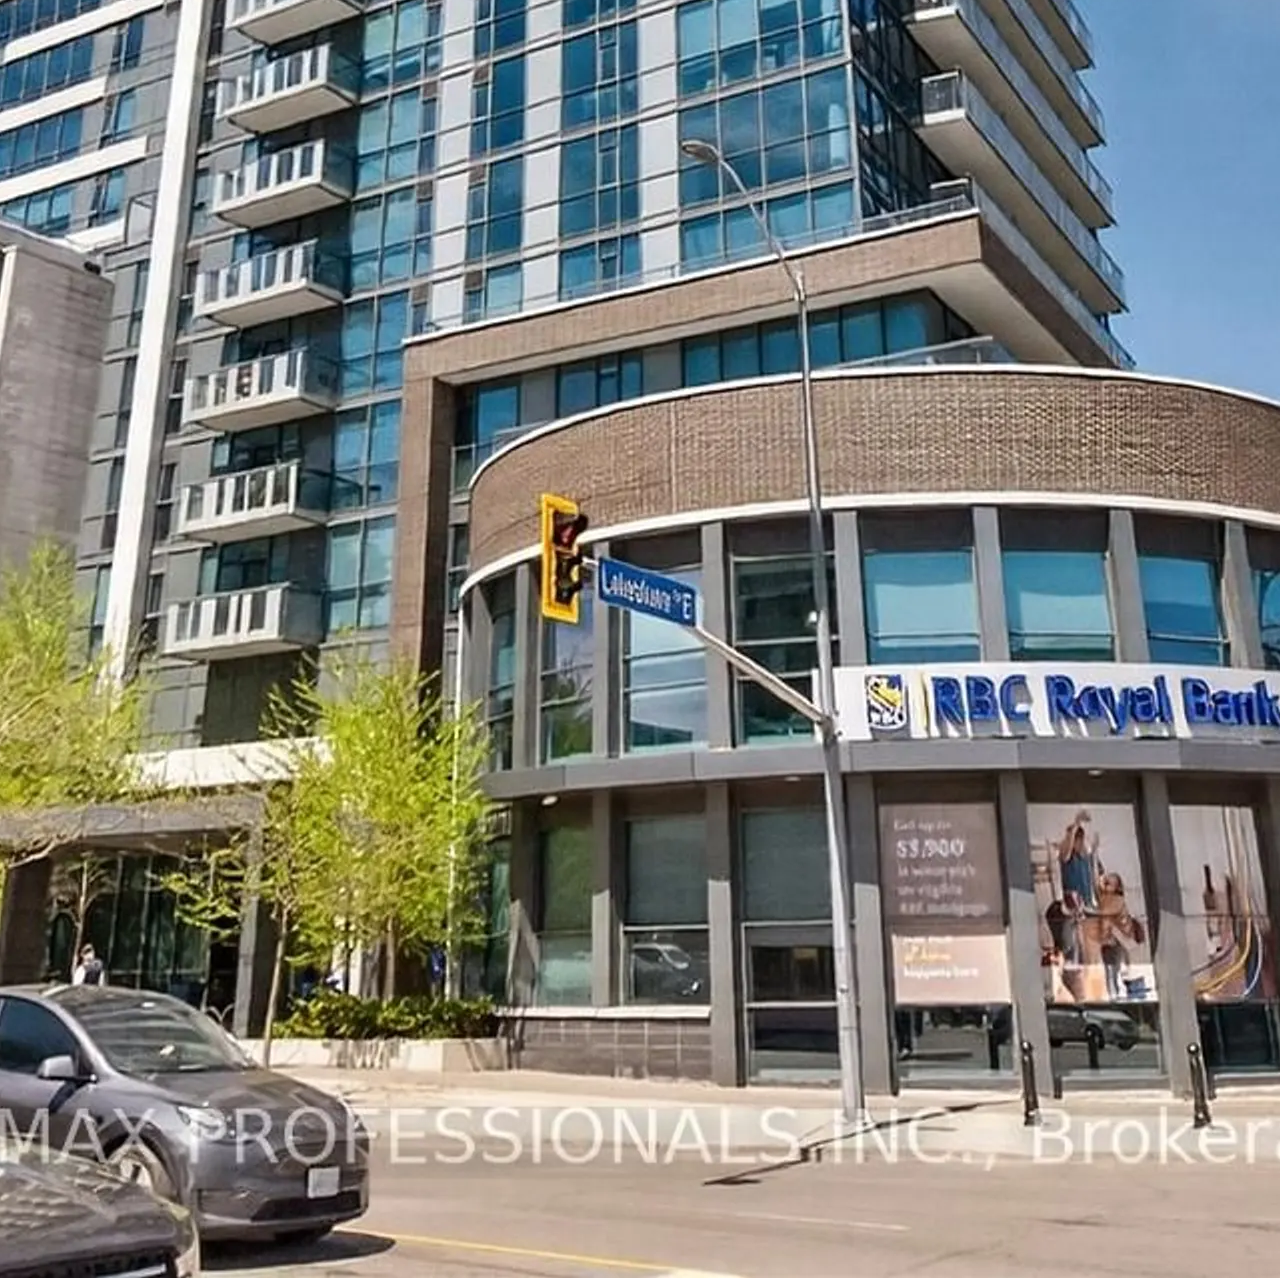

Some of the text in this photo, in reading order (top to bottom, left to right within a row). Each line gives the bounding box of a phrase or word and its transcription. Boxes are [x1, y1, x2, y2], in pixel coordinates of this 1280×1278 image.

[683, 592, 693, 620] E
[931, 673, 1031, 725] RBC
[1045, 674, 1172, 735] Royal
